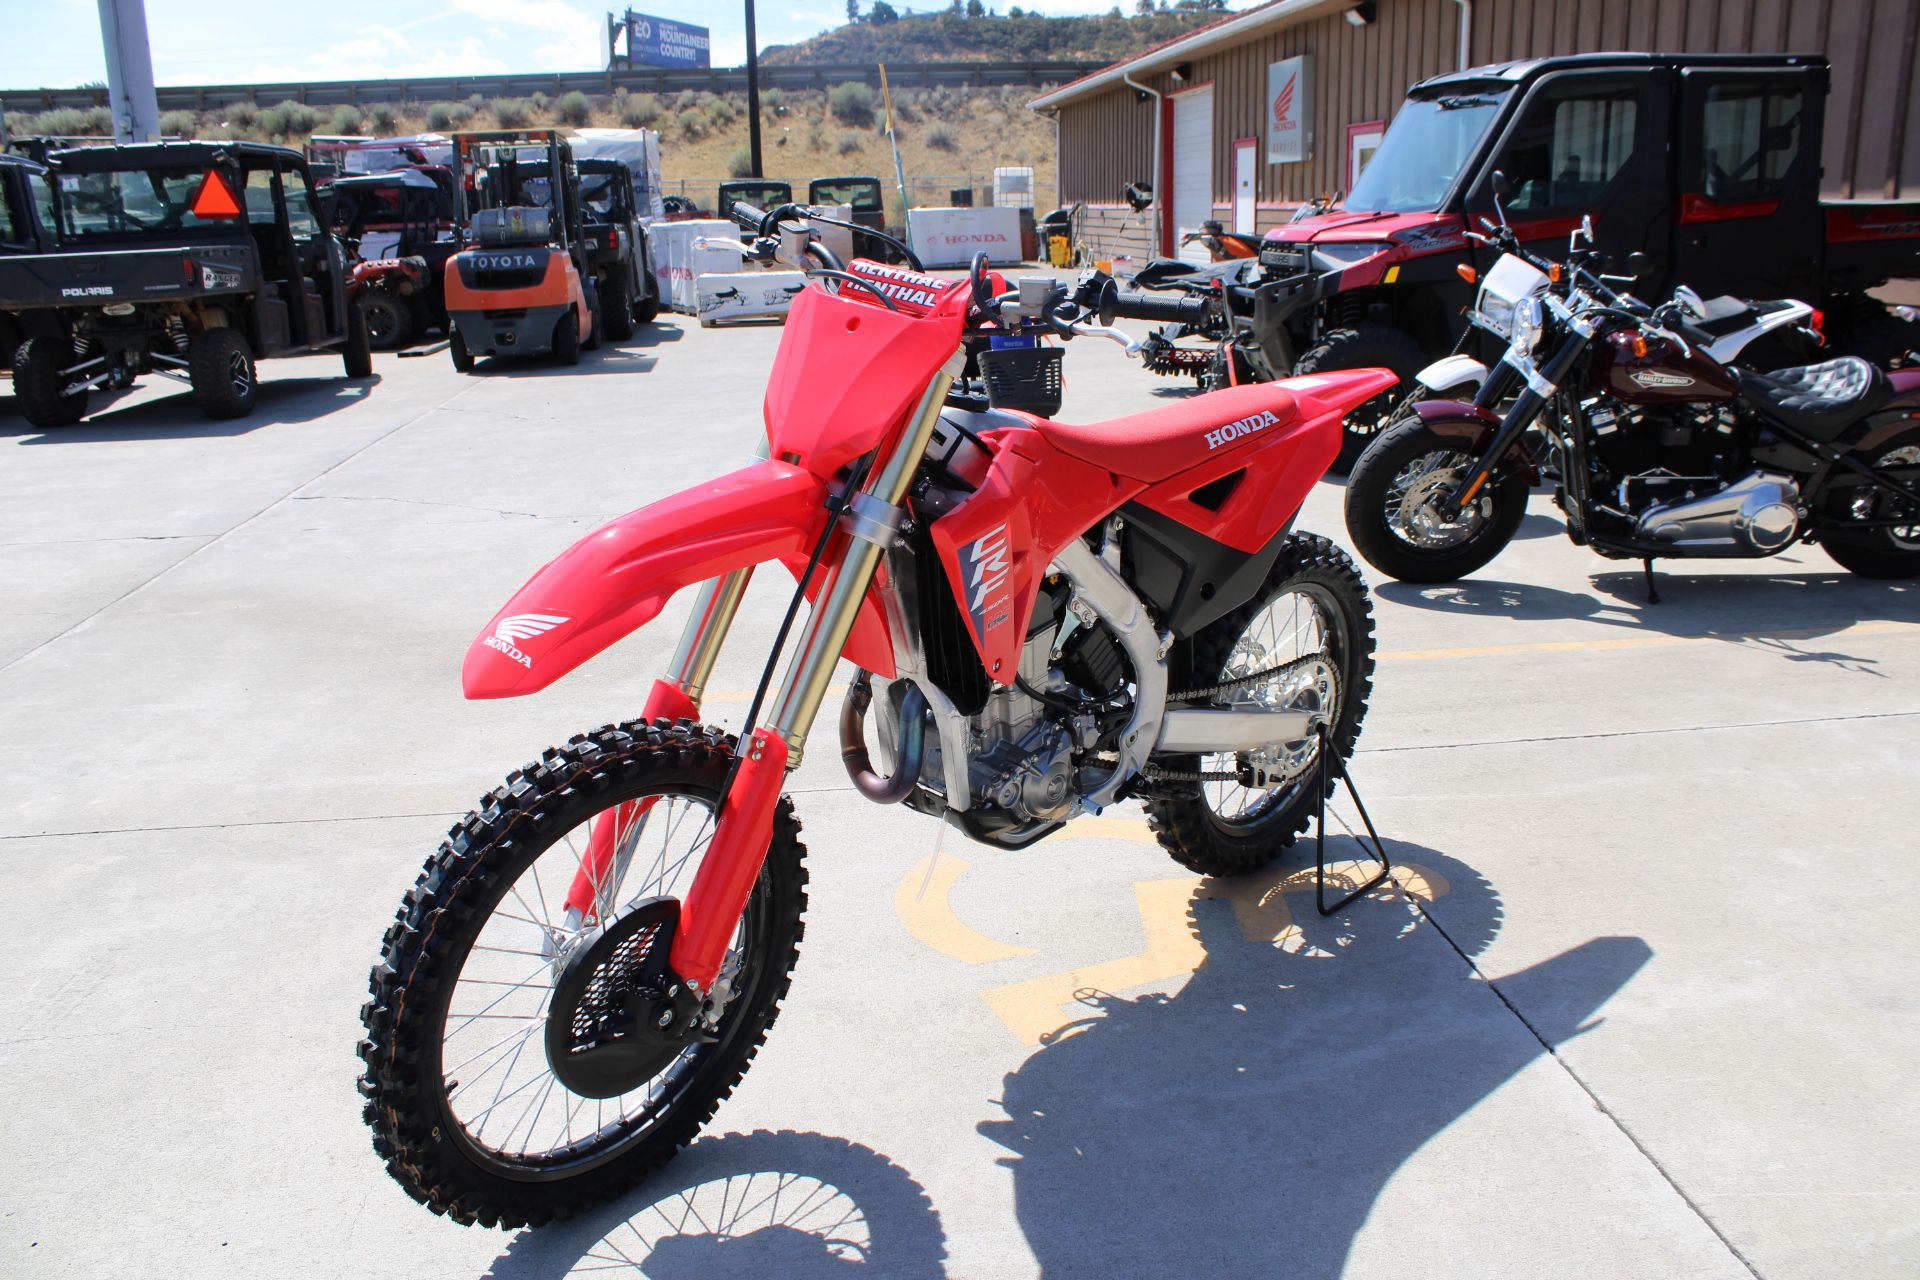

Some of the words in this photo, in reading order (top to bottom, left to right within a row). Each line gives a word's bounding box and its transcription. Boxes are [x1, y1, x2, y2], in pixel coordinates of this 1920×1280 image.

[660, 29, 709, 50] MOUNTAINEER
[660, 43, 696, 61] COUNTRY!
[1273, 120, 1297, 132] HONDA
[944, 234, 1008, 245] HONDA
[469, 255, 536, 269] TOYOTA
[205, 273, 240, 283] RANGER
[854, 262, 944, 290] RENTHAL
[62, 286, 114, 297] POLARIS
[1204, 410, 1280, 449] HONDA
[969, 522, 1010, 613] CRF
[482, 635, 532, 669] HONDA
